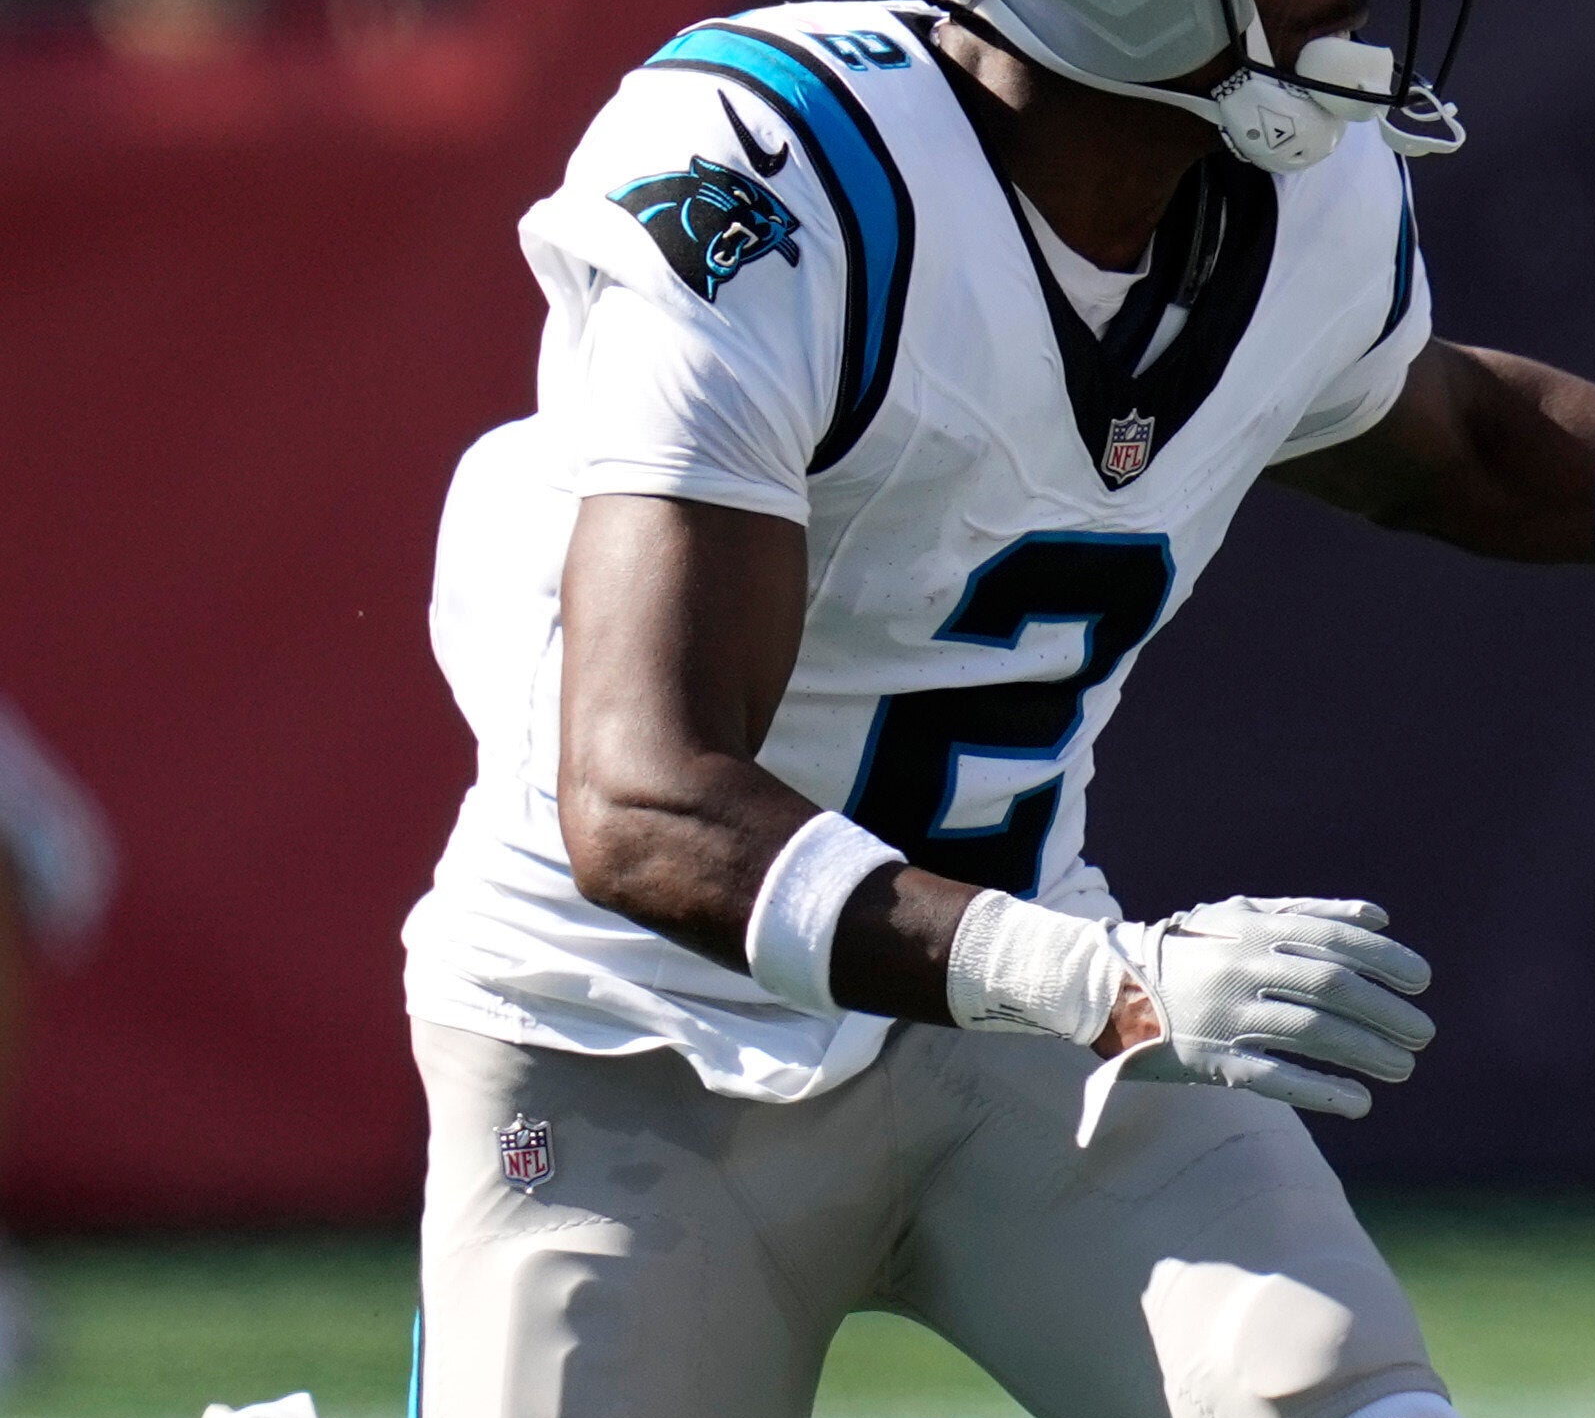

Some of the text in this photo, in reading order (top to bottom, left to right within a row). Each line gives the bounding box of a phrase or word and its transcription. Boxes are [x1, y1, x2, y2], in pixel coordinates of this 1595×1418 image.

[1109, 444, 1142, 471] NFL
[840, 530, 1177, 902] 2
[507, 1149, 546, 1179] NFL
